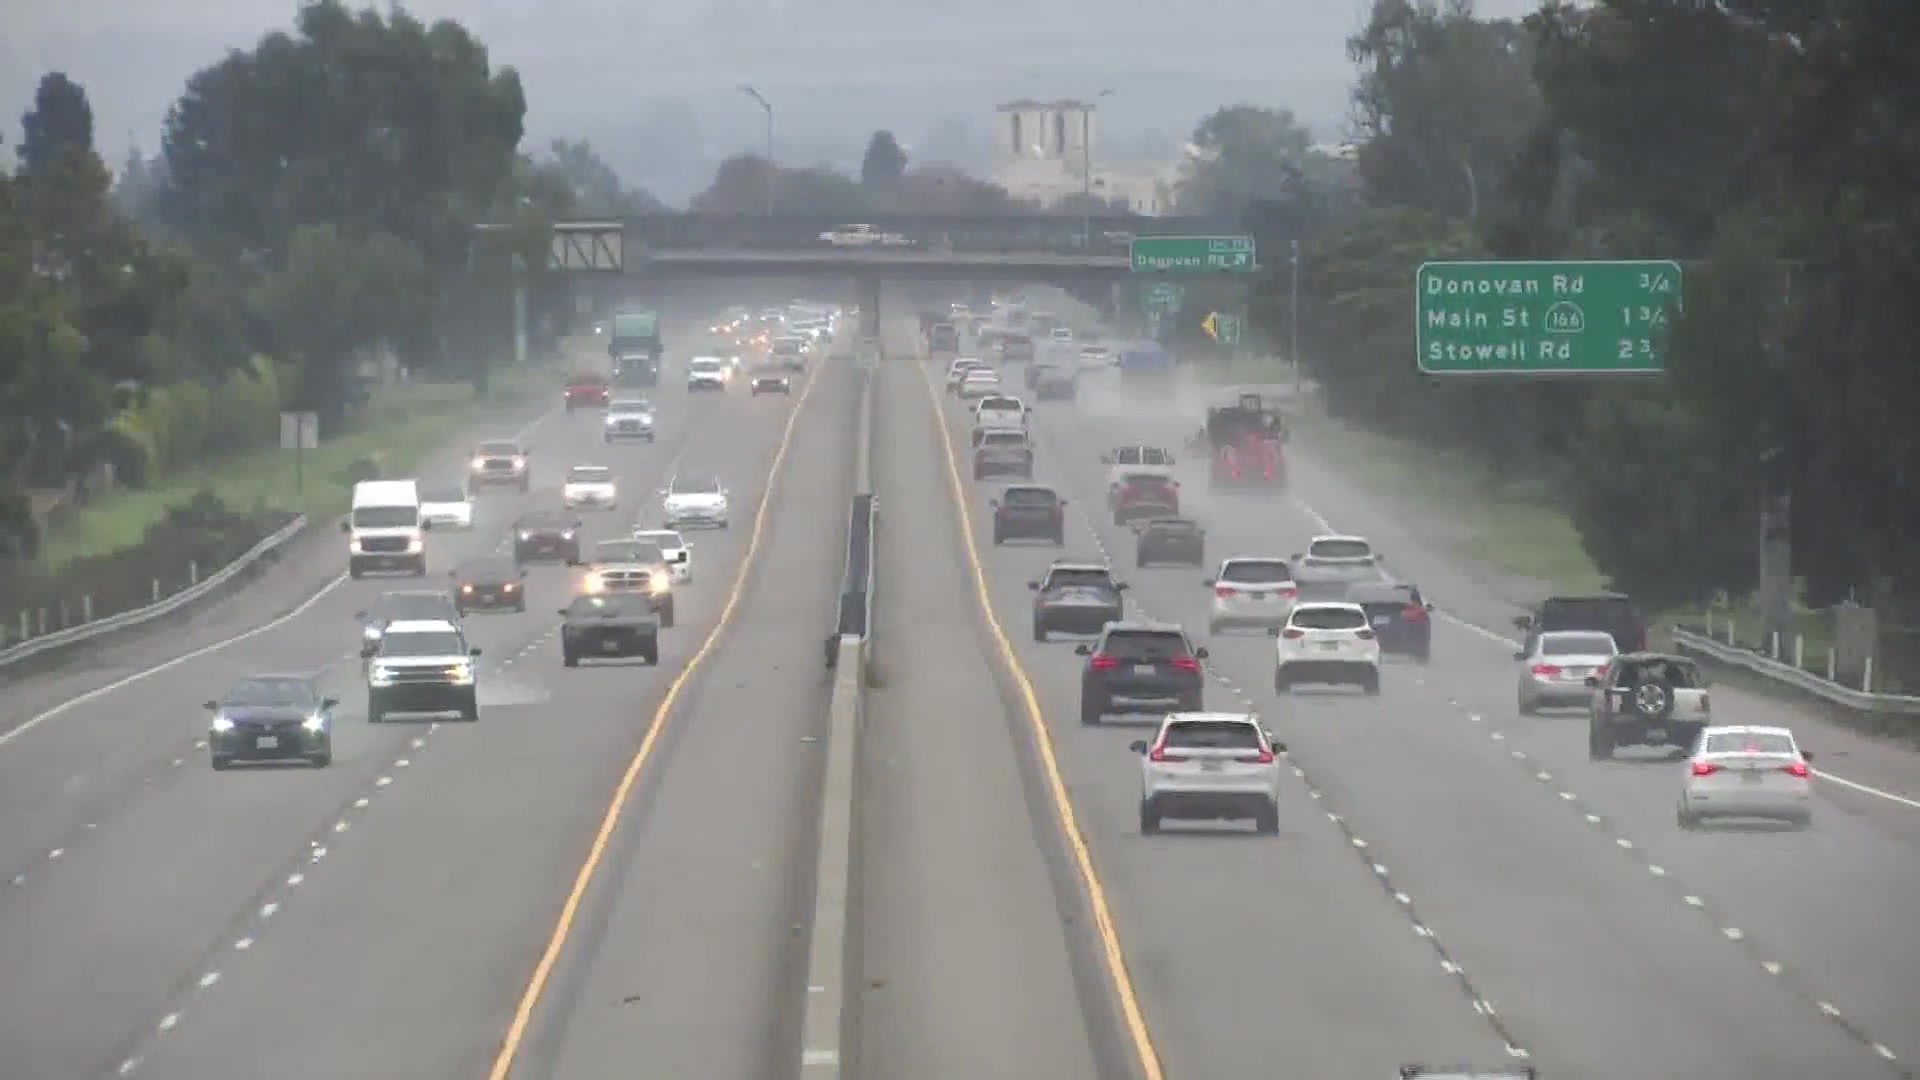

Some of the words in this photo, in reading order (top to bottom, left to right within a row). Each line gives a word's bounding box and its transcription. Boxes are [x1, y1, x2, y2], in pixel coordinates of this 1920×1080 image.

[1428, 275, 1539, 295] Donovan
[1552, 274, 1584, 294] Rd
[1427, 309, 1488, 328] Main
[1502, 308, 1530, 327] St
[1552, 311, 1580, 326] 166
[1429, 340, 1527, 360] Stowell
[1539, 340, 1571, 359] Rd
